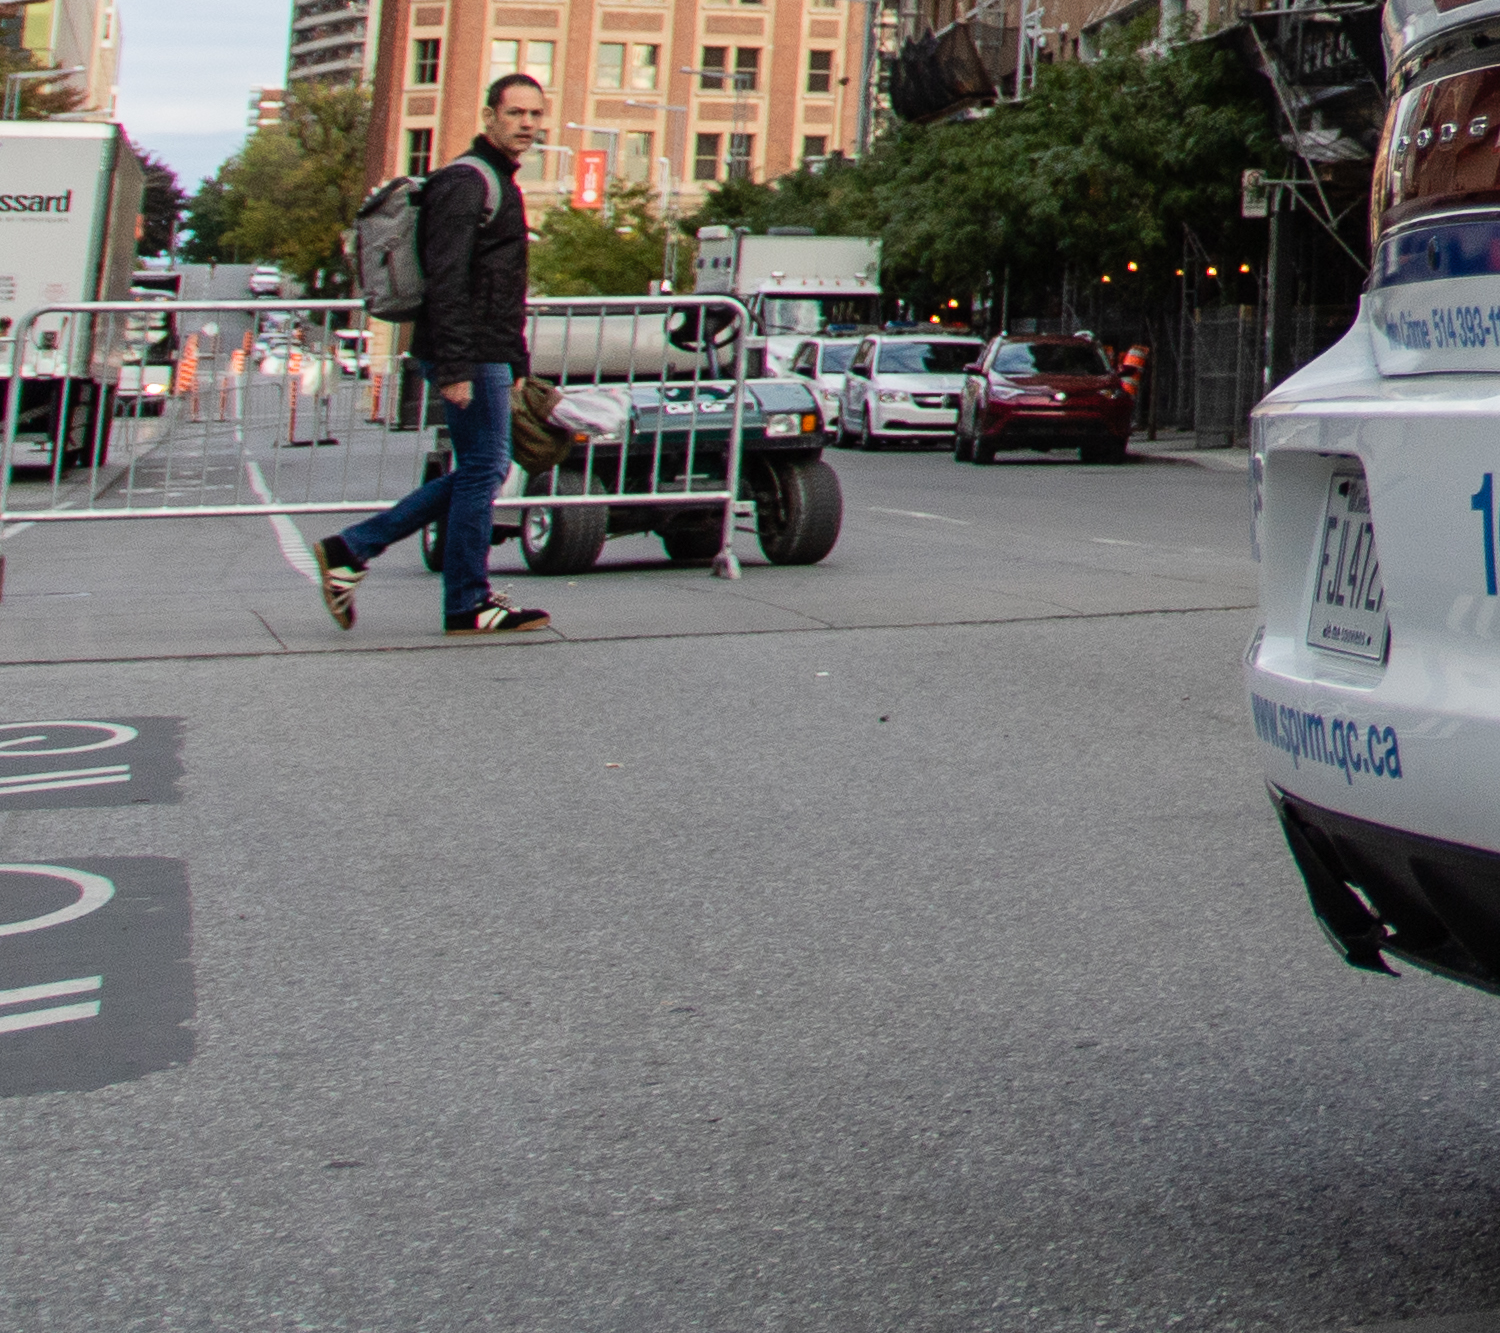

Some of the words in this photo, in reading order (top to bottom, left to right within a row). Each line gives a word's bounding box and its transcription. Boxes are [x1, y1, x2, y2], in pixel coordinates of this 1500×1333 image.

[1431, 307, 1457, 348] 514
[1316, 516, 1384, 613] FJL472
[1250, 691, 1403, 786] www.spvm.qc.ca
